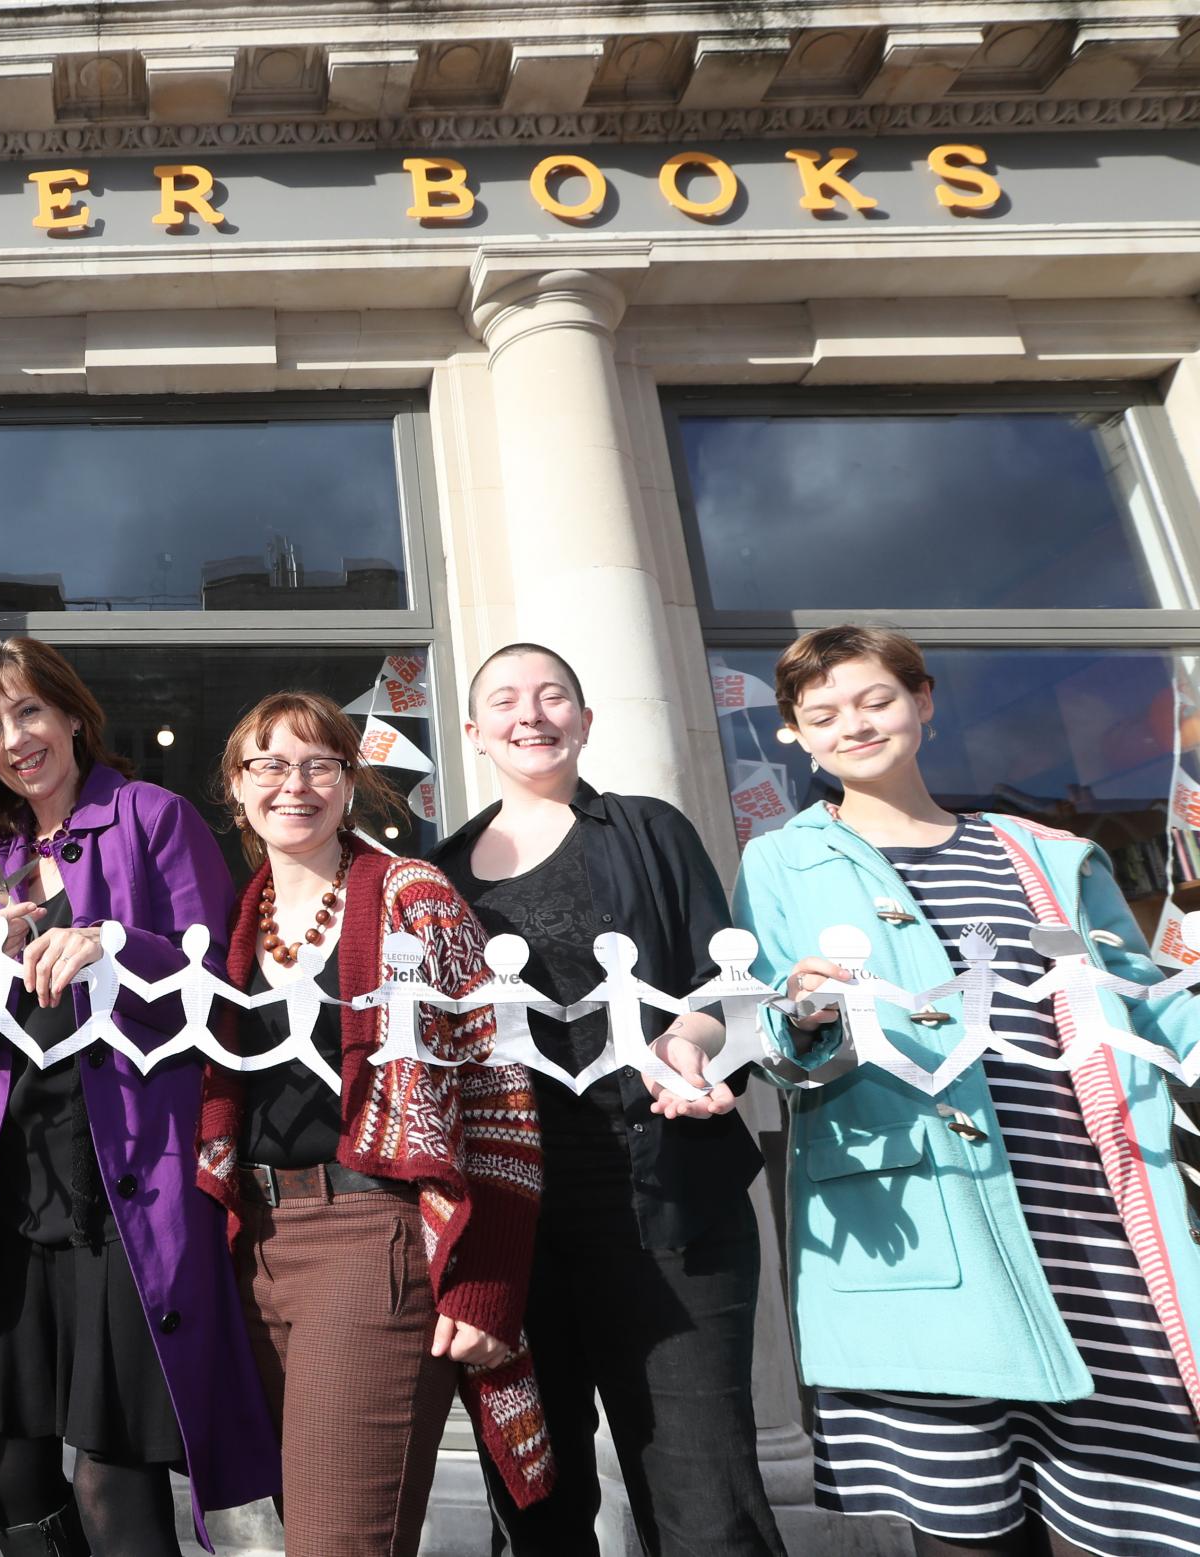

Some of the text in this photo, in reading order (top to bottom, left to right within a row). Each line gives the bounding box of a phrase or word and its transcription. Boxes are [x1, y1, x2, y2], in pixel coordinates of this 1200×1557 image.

[402, 143, 1002, 220] BOOKS
[385, 679, 409, 713] BAG
[725, 674, 745, 707] BAG
[371, 731, 398, 763] BAG
[420, 783, 436, 818] BAG
[758, 780, 786, 815] BOOKS
